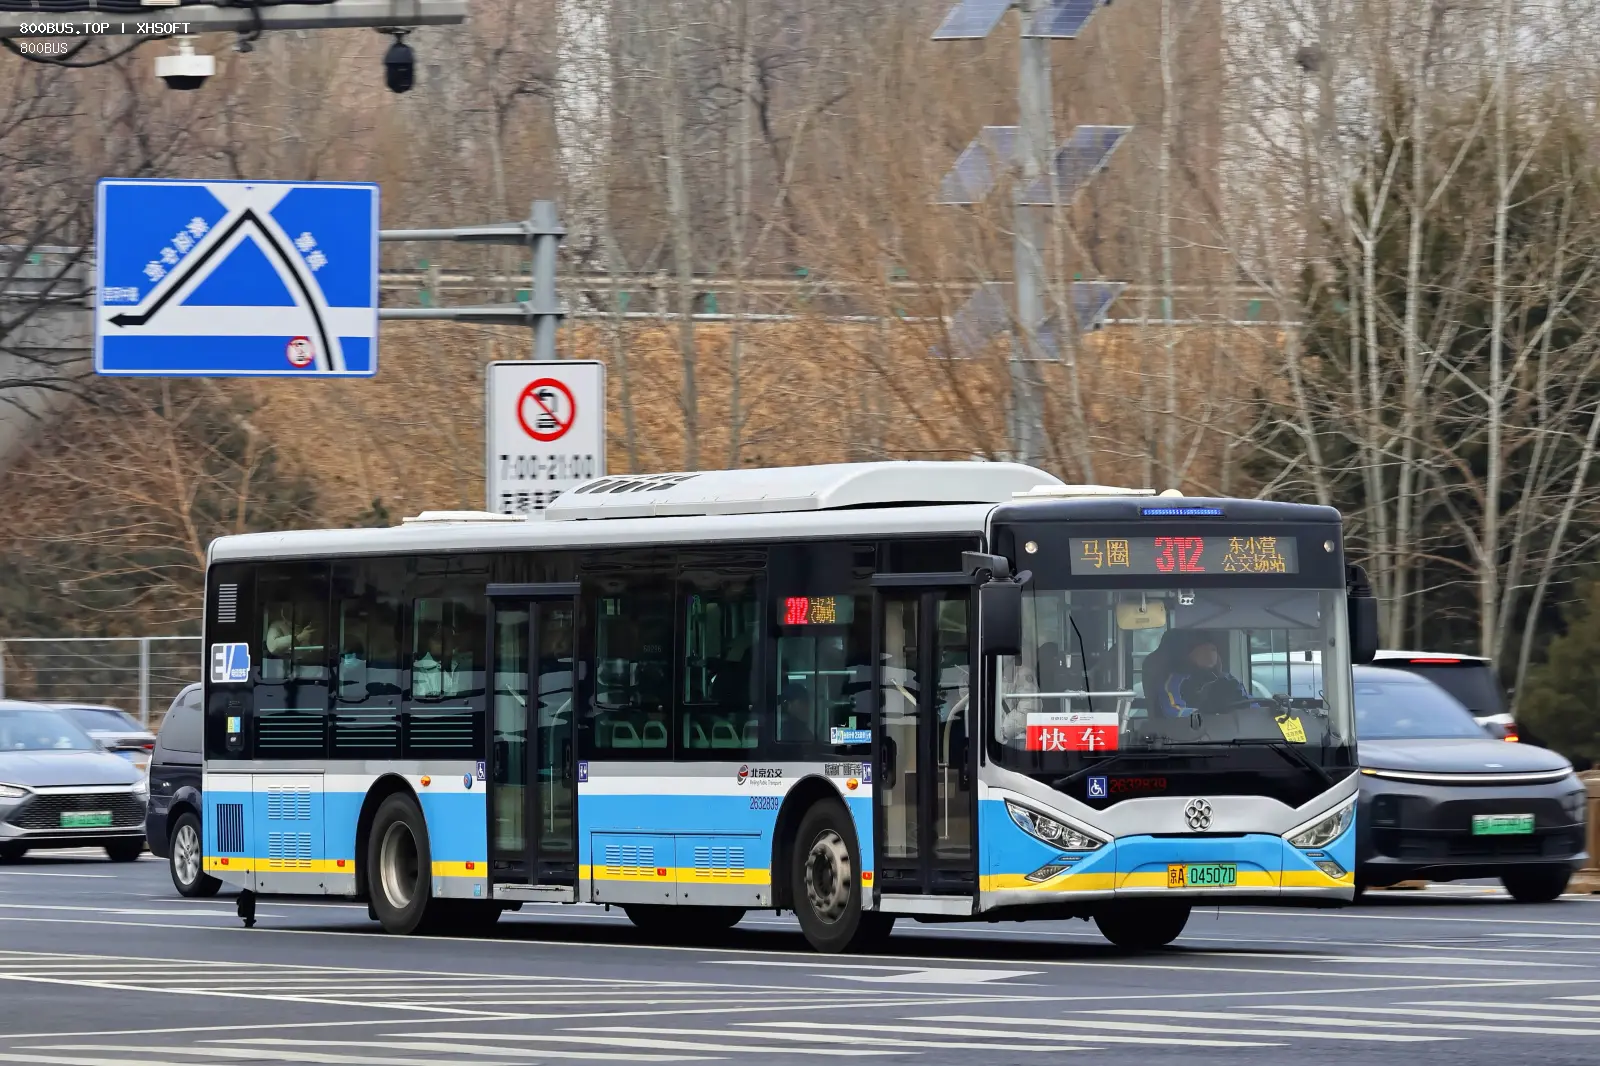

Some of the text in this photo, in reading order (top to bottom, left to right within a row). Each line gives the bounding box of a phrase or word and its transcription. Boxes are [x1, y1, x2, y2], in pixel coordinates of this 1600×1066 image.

[1080, 536, 1276, 572] 马圈 312 东小营
[1221, 553, 1286, 573] 公交场站
[784, 597, 809, 625] 312
[1038, 727, 1106, 751] 快车
[750, 768, 783, 778] 北京公交
[750, 796, 779, 810] 2632839
